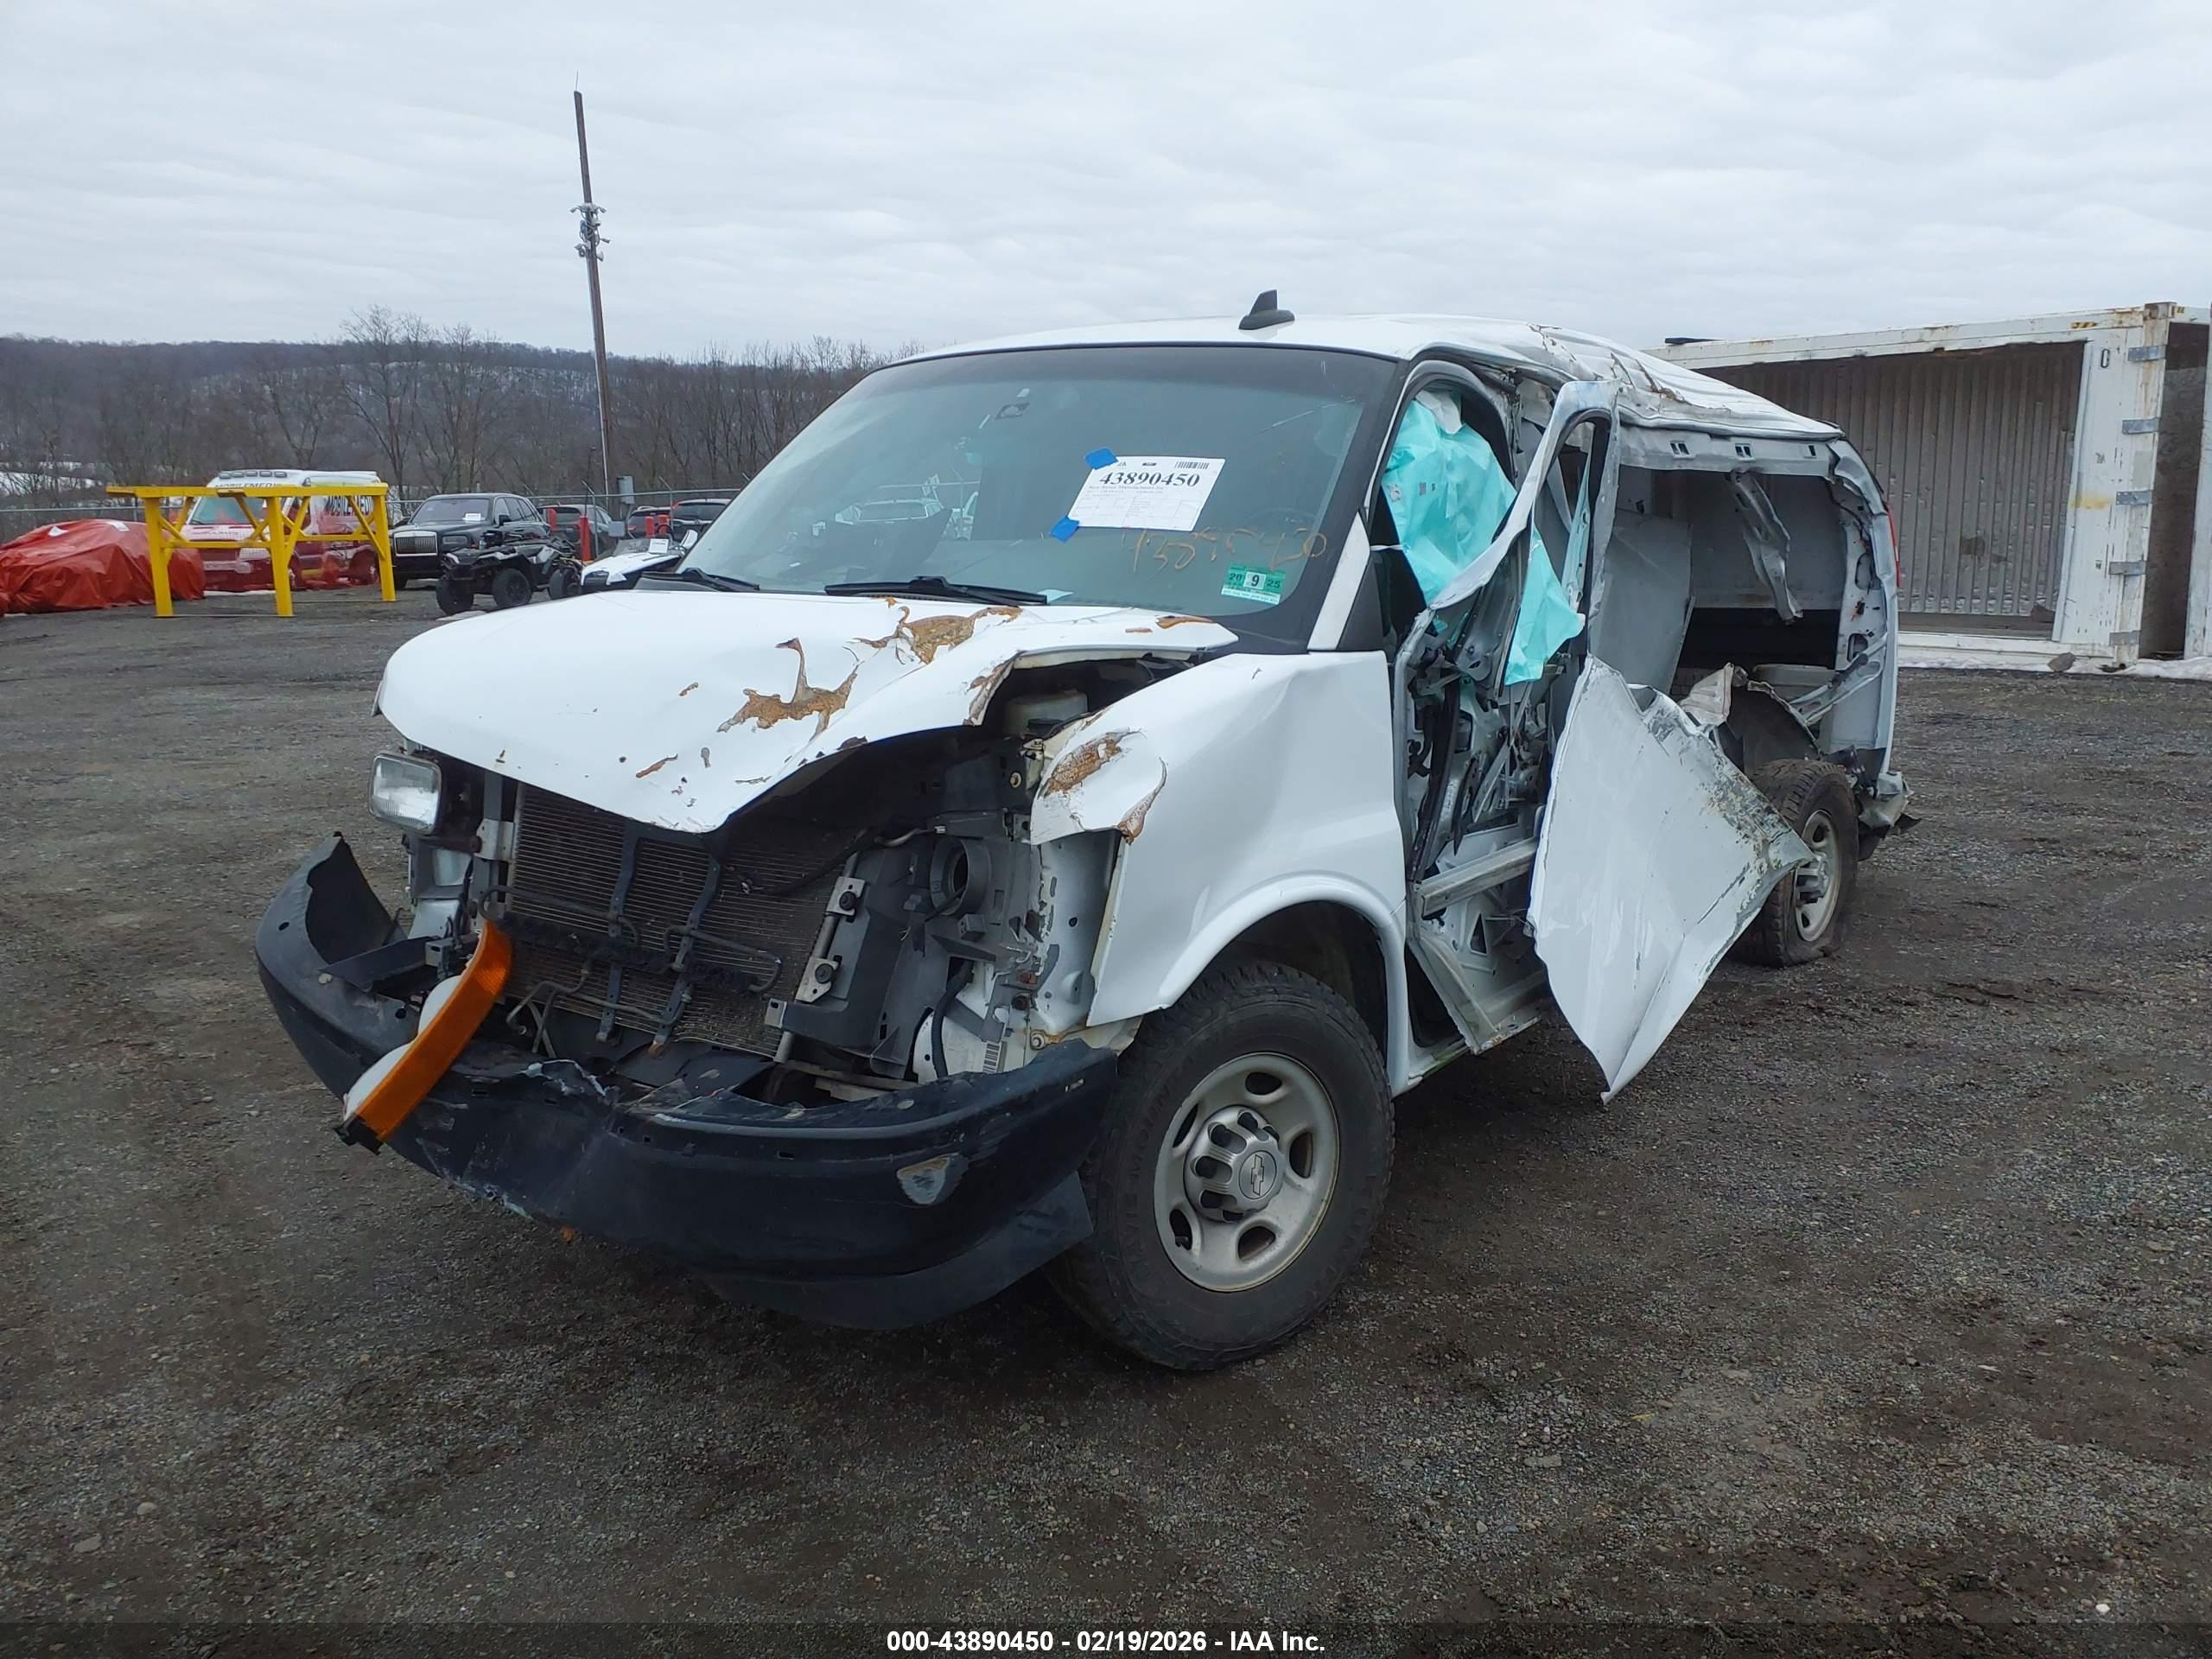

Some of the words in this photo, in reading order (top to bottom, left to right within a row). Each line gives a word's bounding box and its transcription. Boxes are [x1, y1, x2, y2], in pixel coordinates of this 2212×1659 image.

[1099, 472, 1200, 487] 43890450
[1230, 573, 1243, 582] 20
[1250, 574, 1260, 587] 9
[1267, 579, 1281, 588] 25
